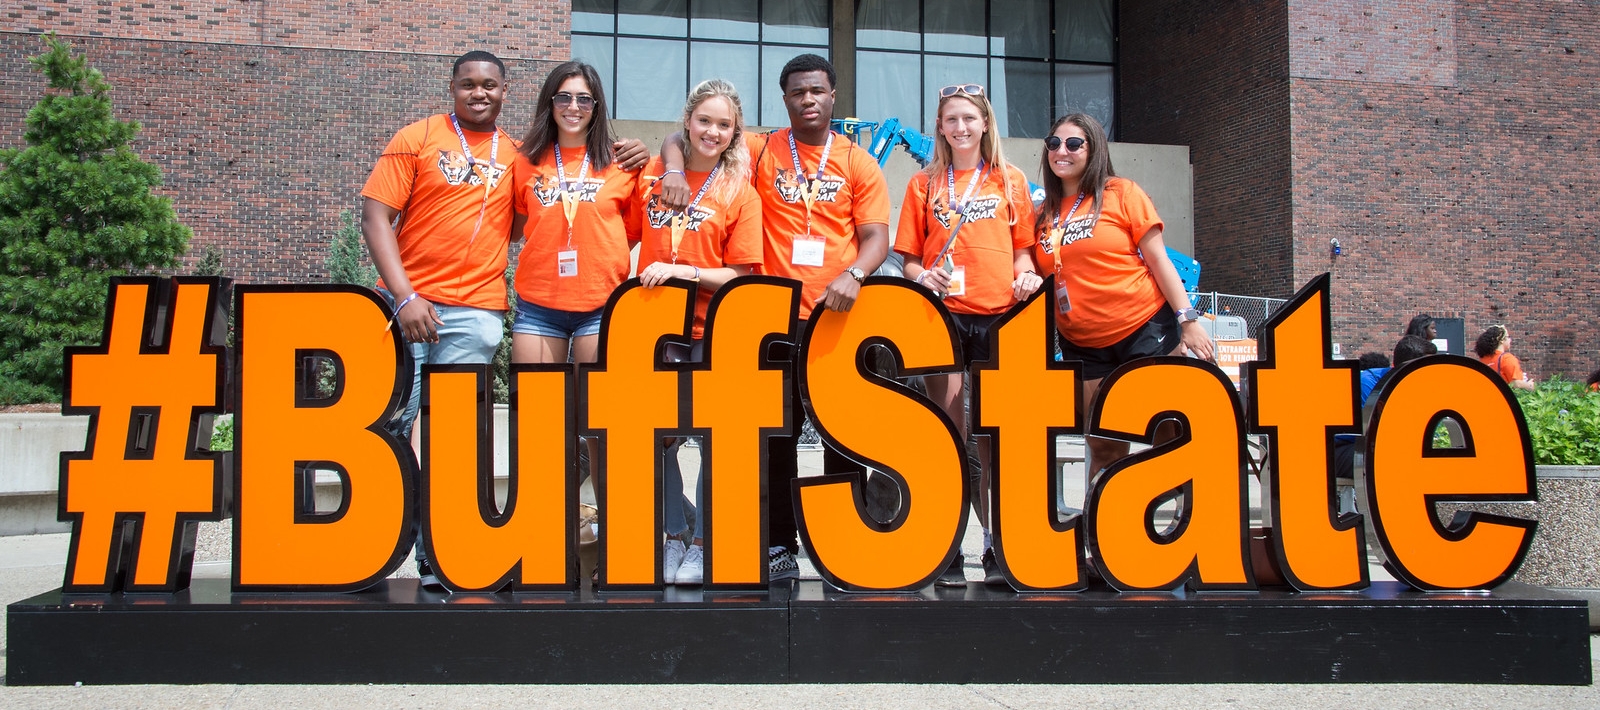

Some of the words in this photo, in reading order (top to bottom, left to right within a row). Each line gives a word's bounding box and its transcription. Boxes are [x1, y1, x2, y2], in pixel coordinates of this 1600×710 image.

[554, 143, 562, 166] BUFFALO
[792, 149, 802, 174] BUFFALO
[468, 175, 498, 188] ROR
[568, 183, 604, 192] RADY
[701, 166, 718, 191] BUFFALO
[691, 190, 704, 208] STATE
[965, 209, 997, 224] ROAR
[1062, 228, 1094, 246] ROAR
[59, 272, 1538, 592] #BuffState
